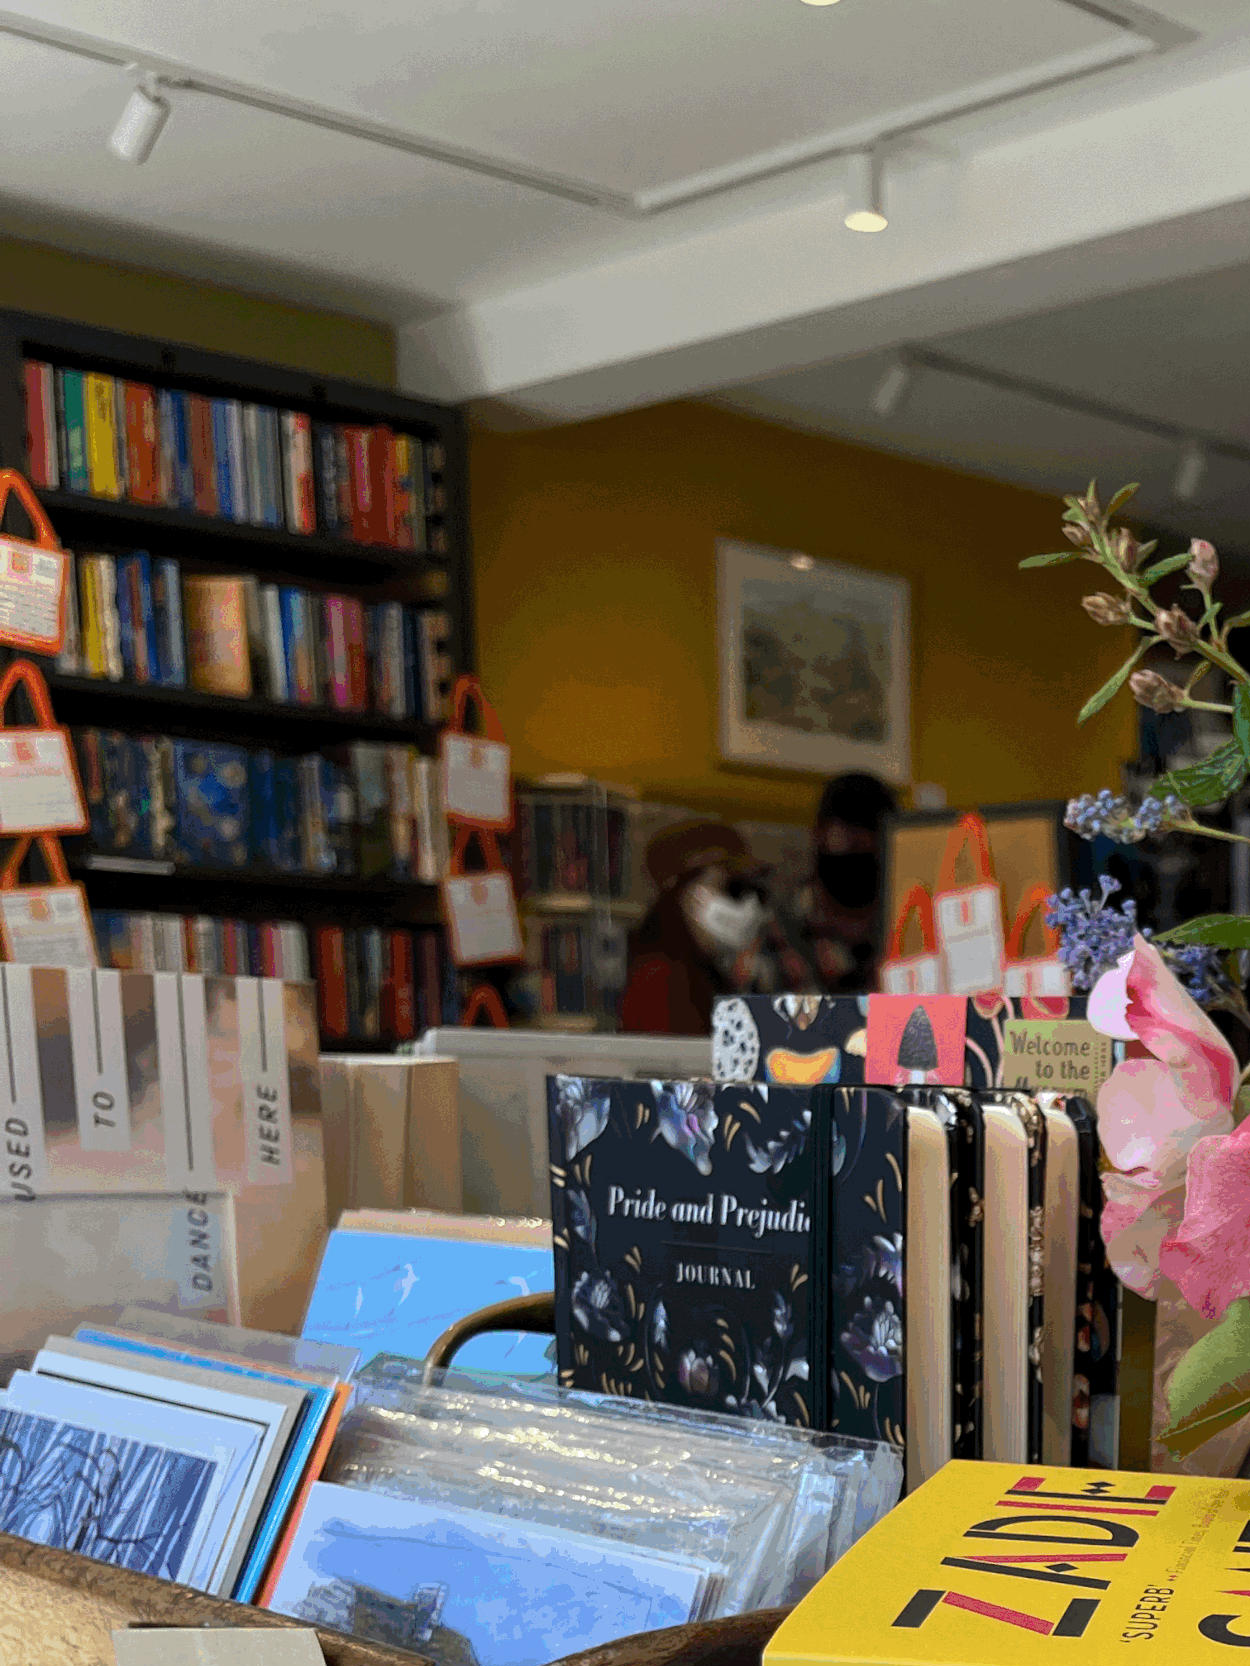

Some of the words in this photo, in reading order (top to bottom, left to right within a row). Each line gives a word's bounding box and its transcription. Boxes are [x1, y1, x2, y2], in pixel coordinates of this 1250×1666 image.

[1010, 1028, 1090, 1057] Welcome
[1035, 1059, 1054, 1079] to
[1060, 1059, 1090, 1080] the
[92, 1090, 116, 1129] TO
[256, 1084, 281, 1166] HERE
[5, 1117, 37, 1203] USED
[608, 1184, 667, 1221] Pride
[671, 1192, 714, 1226] and
[720, 1194, 810, 1239] Prejudi
[184, 1188, 214, 1293] DANCE
[676, 1261, 756, 1290] JOURNAL
[891, 1477, 1177, 1638] ZADIE
